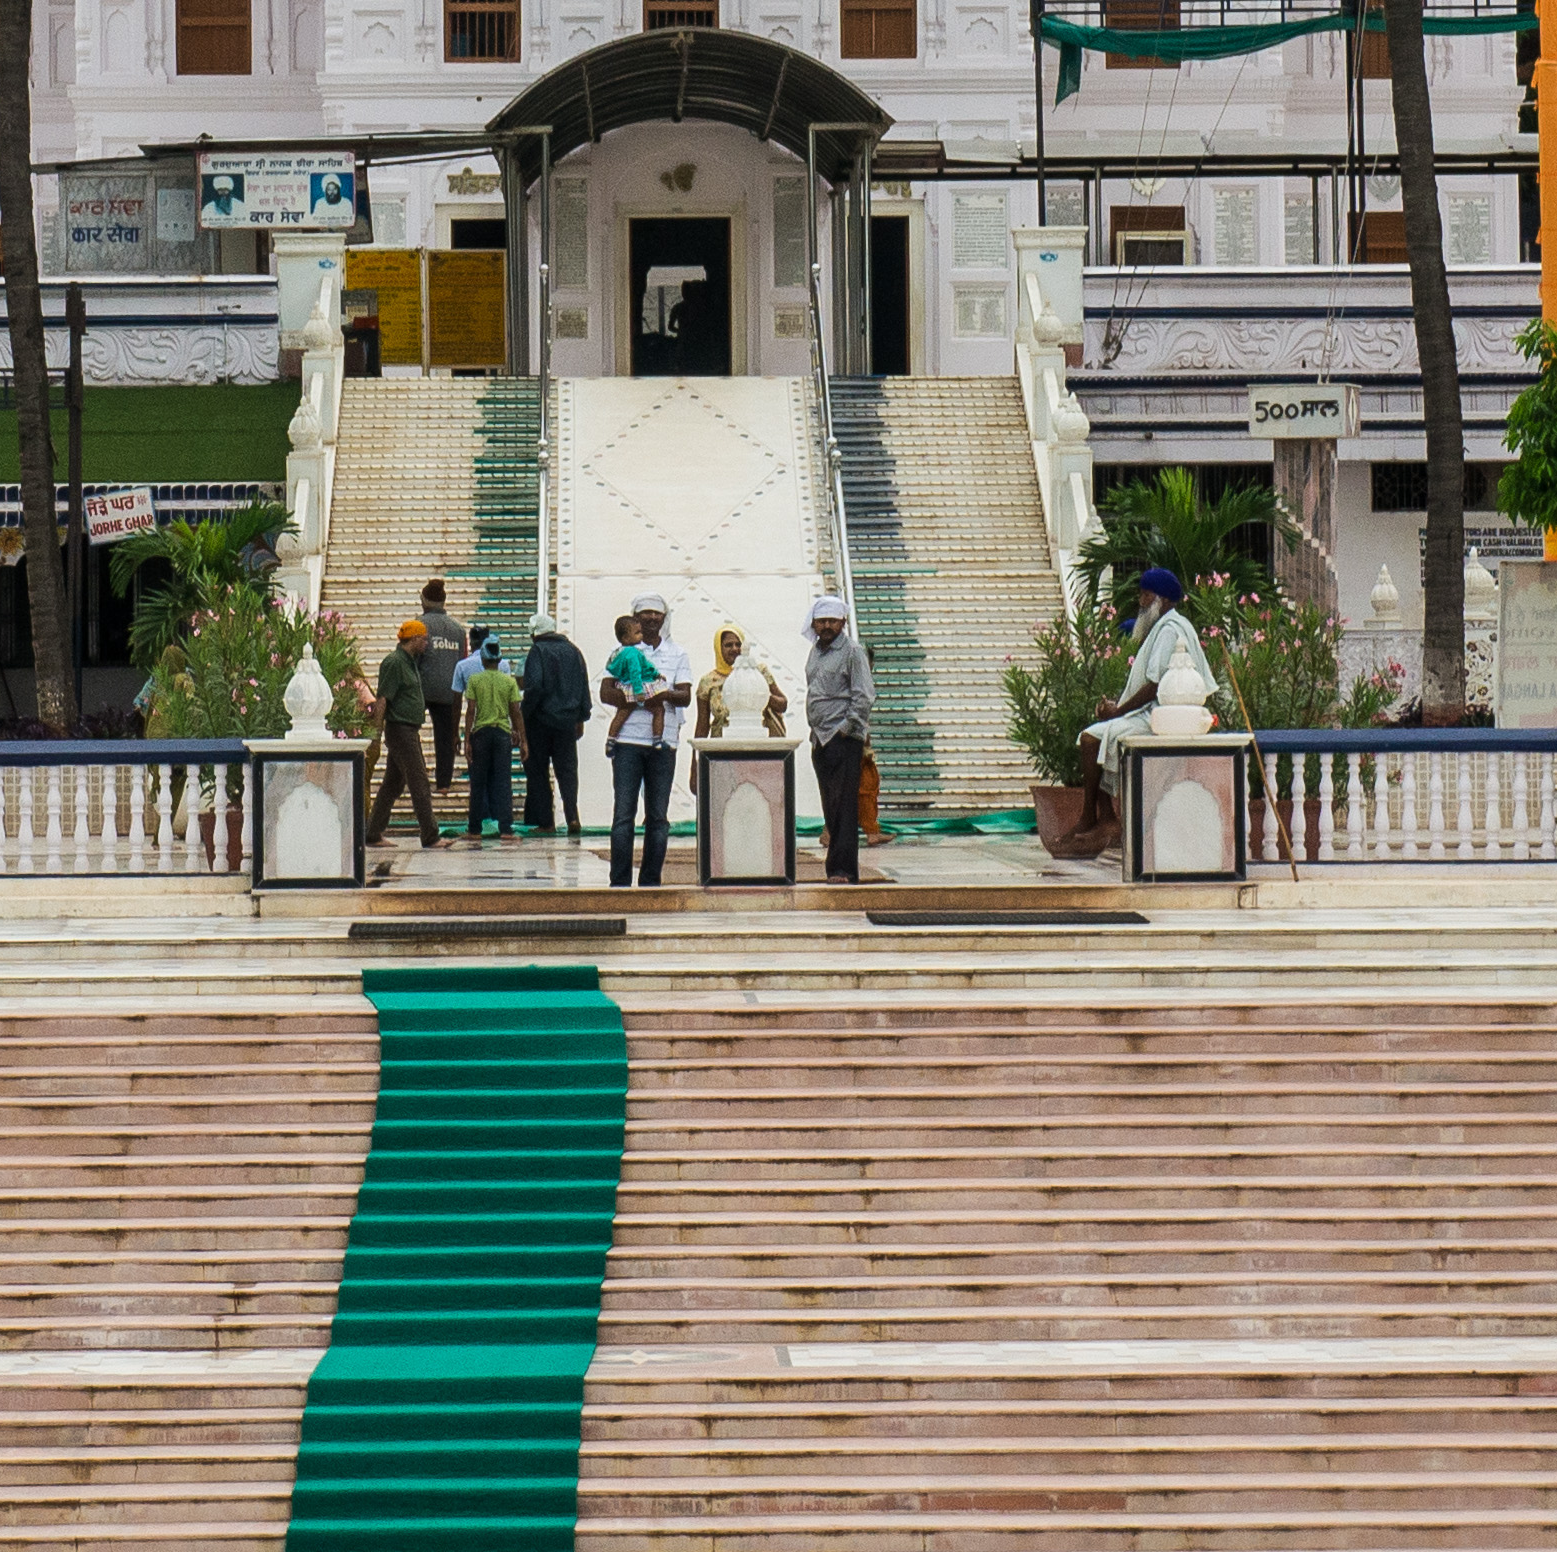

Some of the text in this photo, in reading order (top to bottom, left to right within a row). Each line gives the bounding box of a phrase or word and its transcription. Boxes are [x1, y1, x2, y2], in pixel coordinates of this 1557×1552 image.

[269, 160, 292, 168] ਨਾਨਕ
[318, 158, 343, 168] ਸਾਹਿਬ
[250, 211, 274, 223] ਕਾਰ
[280, 207, 305, 223] ਸੇਵਾ
[71, 223, 141, 243] कार सेवा
[110, 495, 135, 511] ਘਰ
[90, 514, 154, 536] JORHE GHAR
